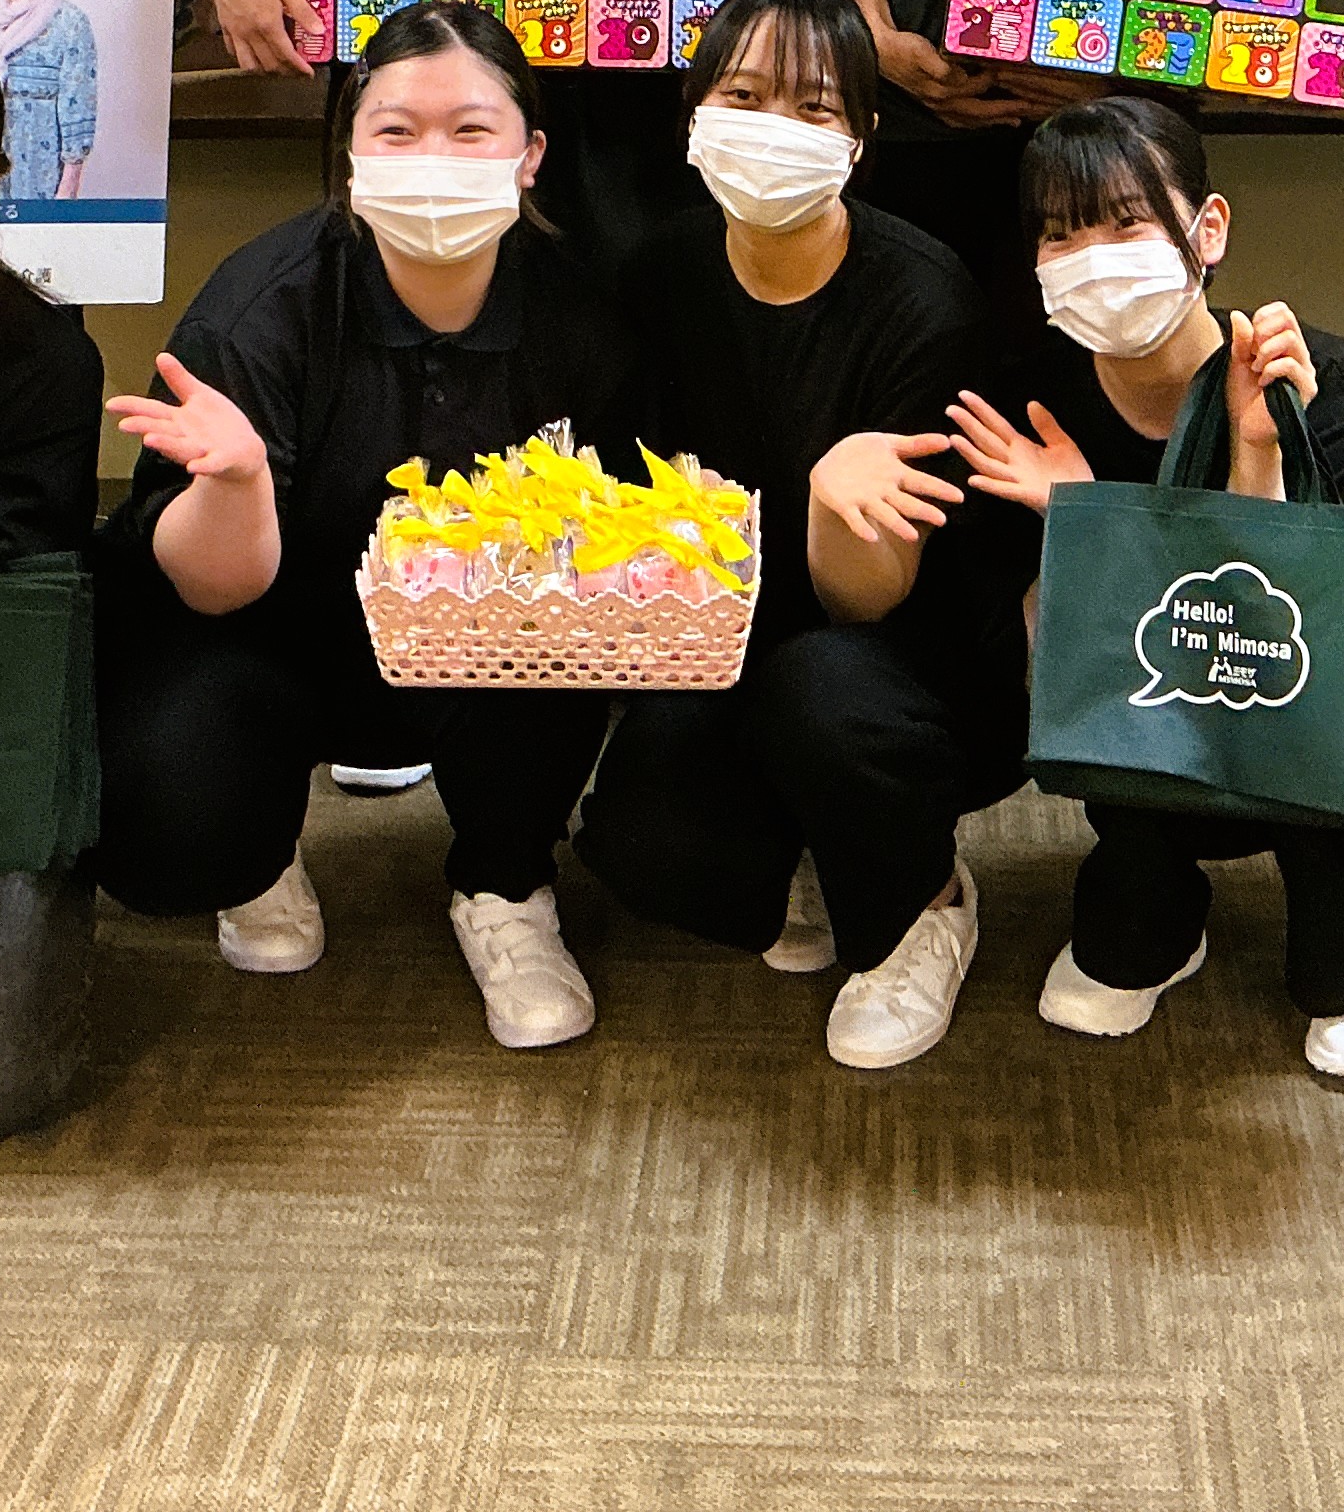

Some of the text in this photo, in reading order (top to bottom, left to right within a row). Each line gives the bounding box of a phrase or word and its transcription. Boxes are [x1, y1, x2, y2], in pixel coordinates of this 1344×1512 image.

[350, 15, 380, 54] 2
[515, 19, 573, 58] 28
[597, 18, 659, 60] 29
[959, 4, 1022, 53] 25
[1045, 15, 1109, 62] 26
[1134, 29, 1196, 75] 27
[1220, 43, 1279, 87] 28
[1173, 600, 1234, 624] Hello!
[1171, 627, 1292, 660] I'm Mimosa
